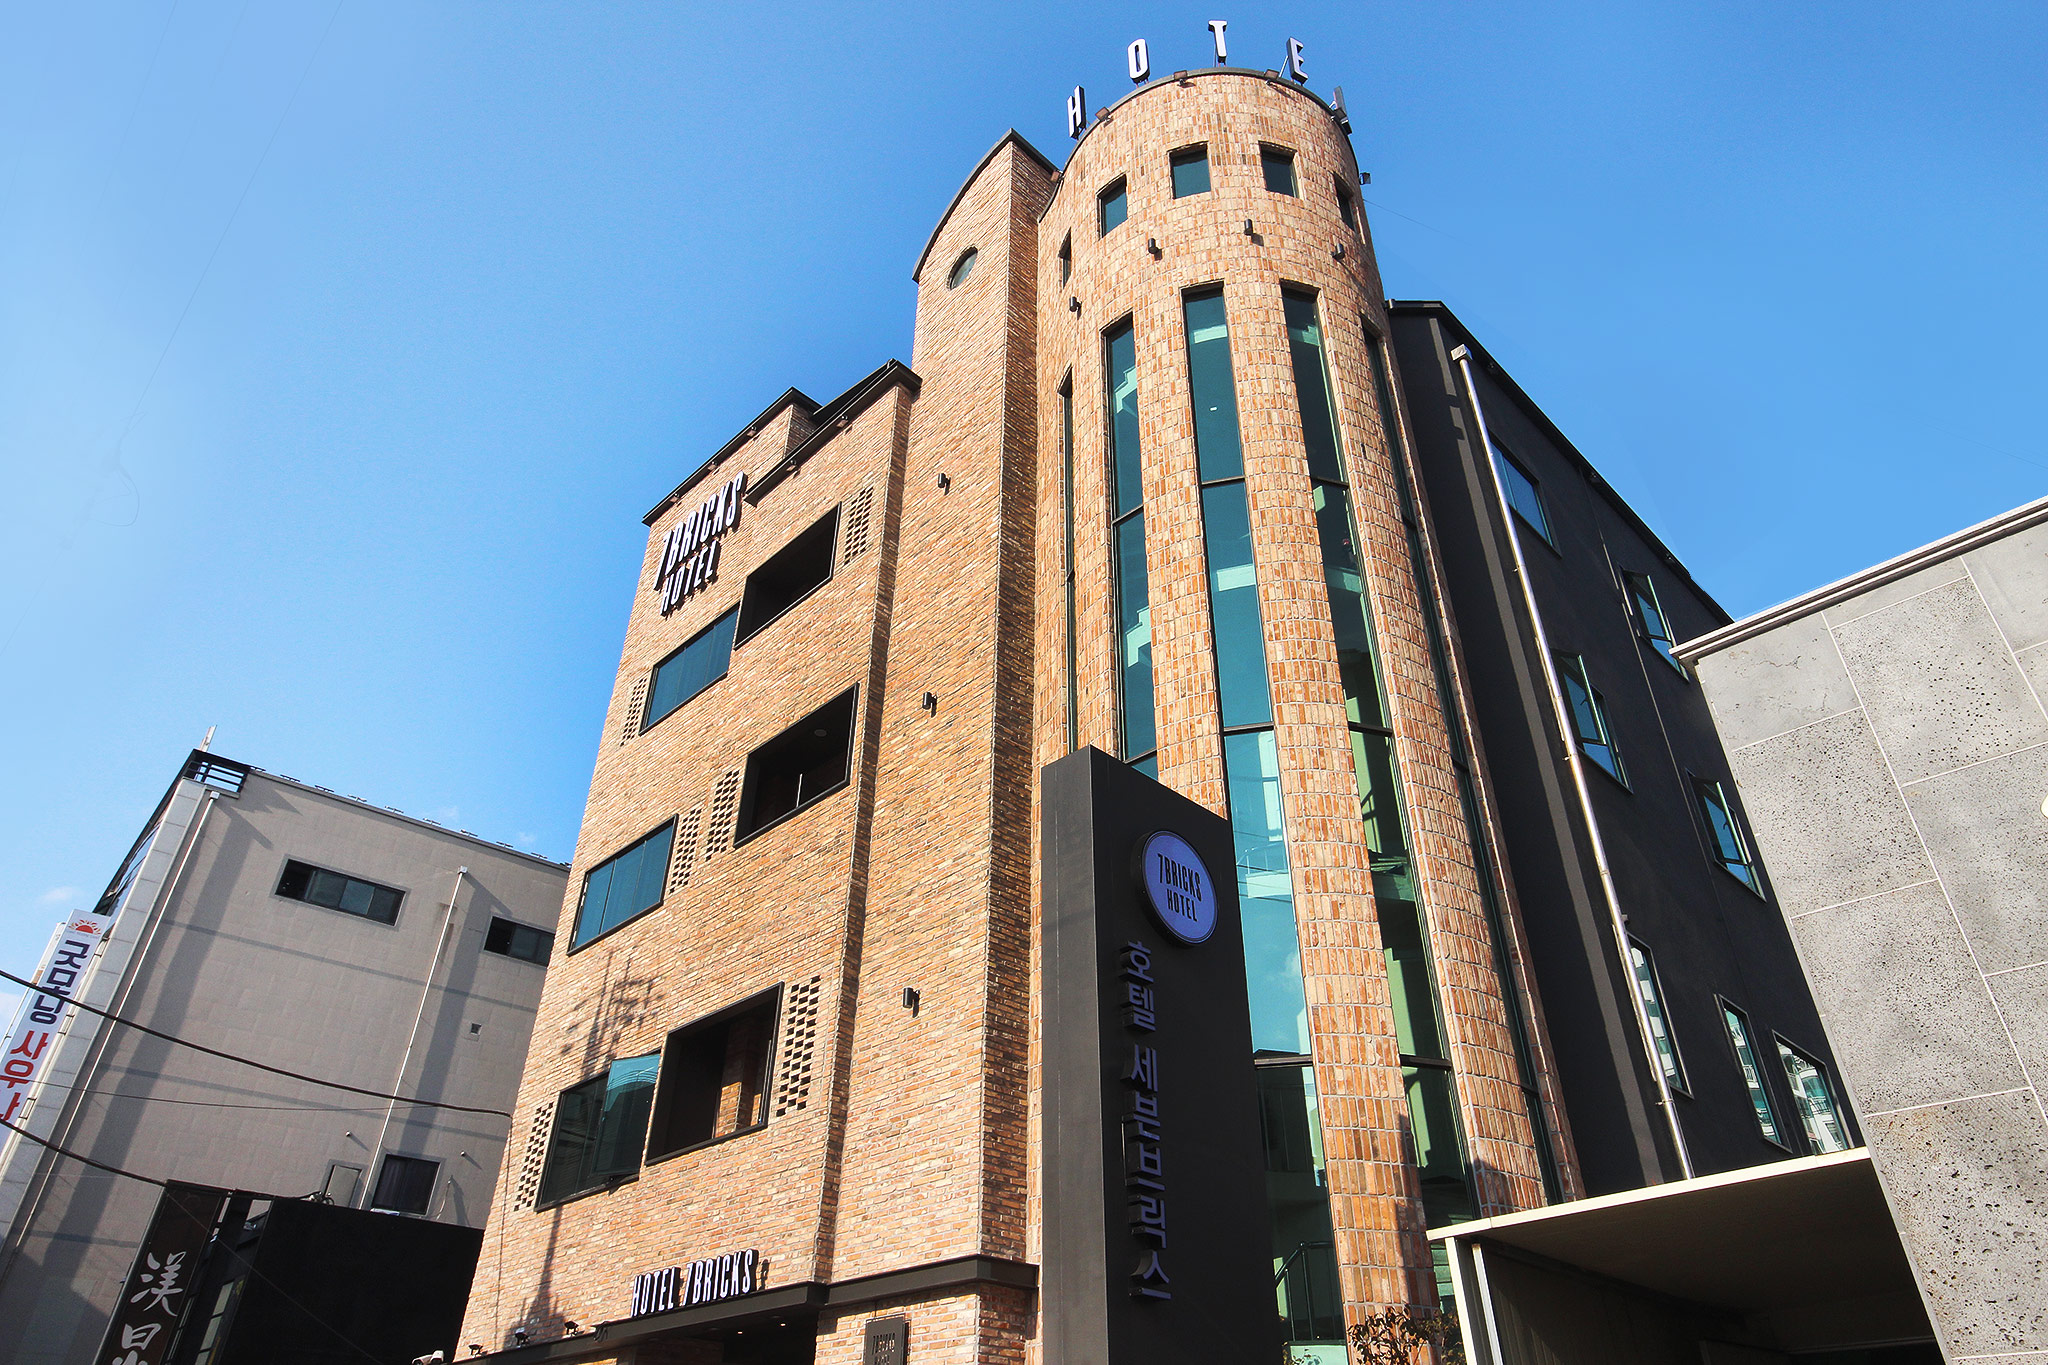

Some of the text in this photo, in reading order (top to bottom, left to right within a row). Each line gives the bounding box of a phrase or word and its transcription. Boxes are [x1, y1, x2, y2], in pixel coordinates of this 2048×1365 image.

[653, 470, 747, 592] 7BRICKS
[660, 540, 719, 617] HOTEL
[1157, 852, 1202, 902] 7BRICKS
[1166, 888, 1198, 922] HOTEL
[1127, 940, 1172, 1299] 호텔 세븐브릭스
[631, 1249, 755, 1318] HOTEL 7BRICKS
